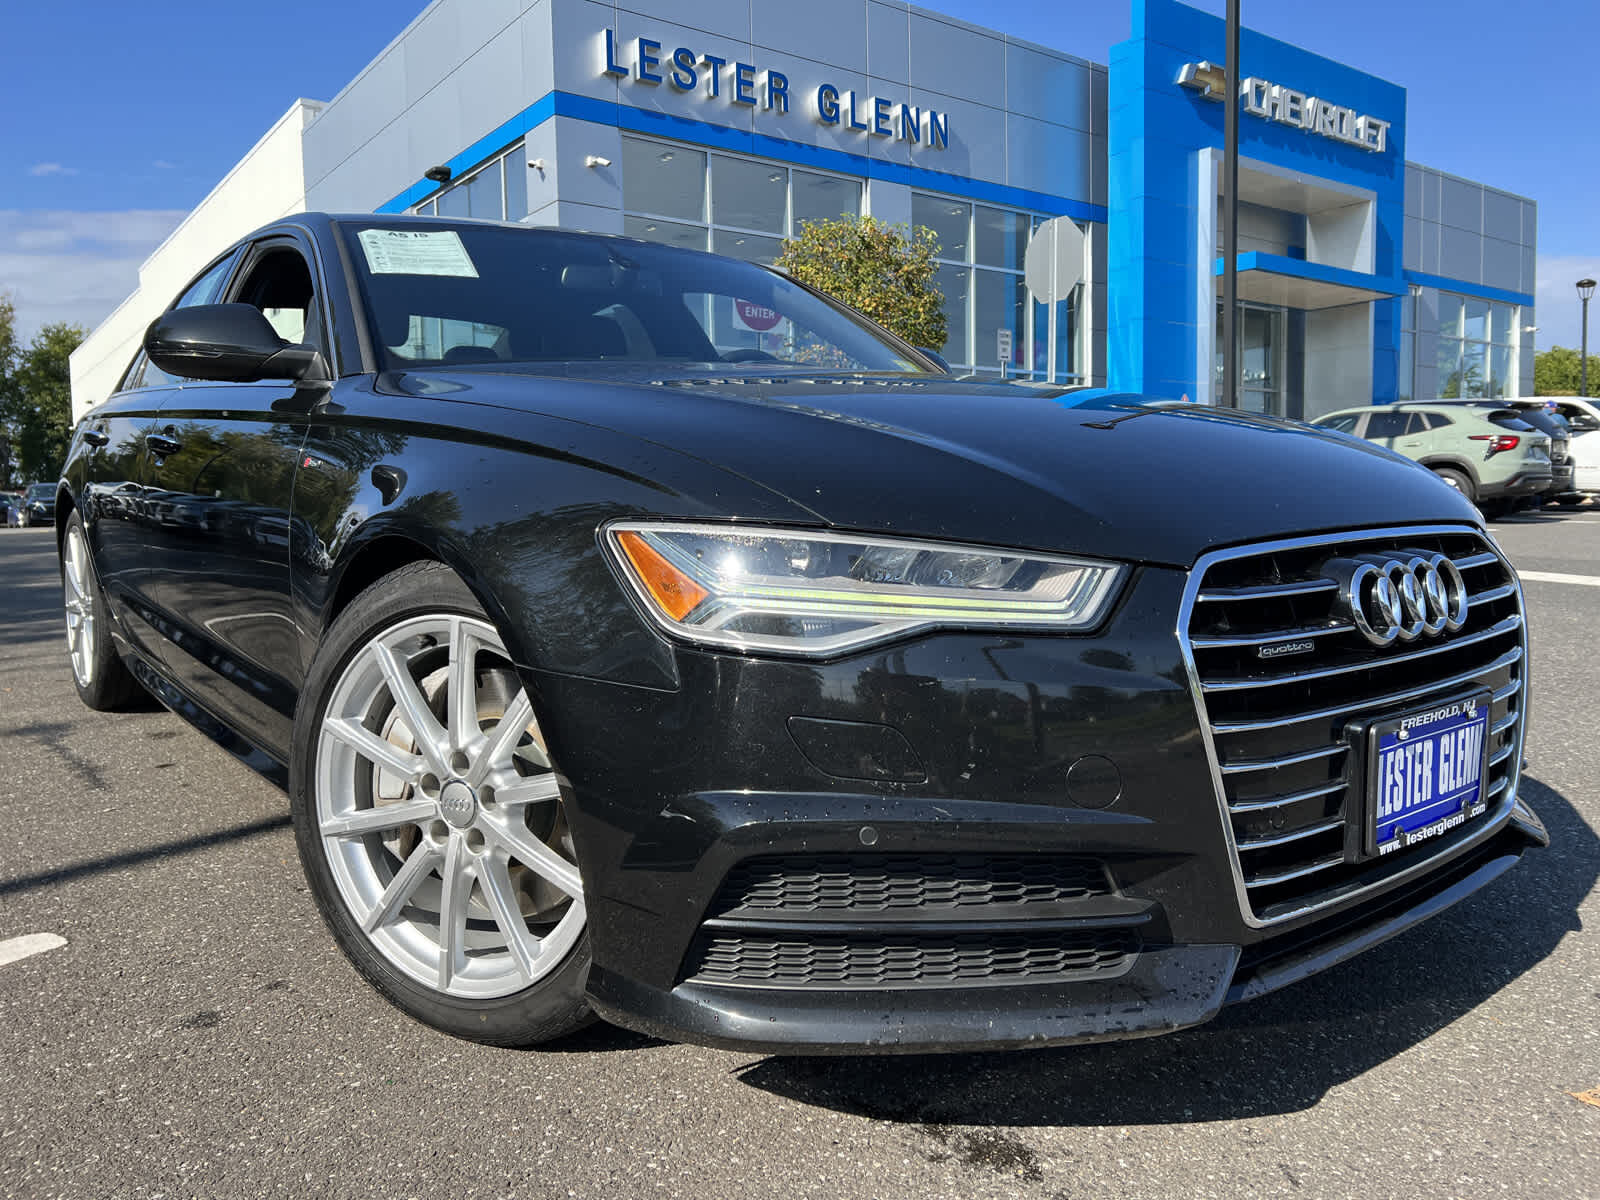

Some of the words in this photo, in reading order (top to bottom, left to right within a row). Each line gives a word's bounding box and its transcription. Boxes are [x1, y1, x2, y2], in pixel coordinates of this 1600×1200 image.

[601, 28, 789, 113] LESTER
[816, 83, 951, 149] GLENN
[1243, 76, 1391, 152] CHEVROLET
[744, 306, 776, 320] ENTER
[1263, 642, 1313, 655] quattro
[1401, 705, 1461, 731] FREEHOLD,
[1377, 739, 1434, 818] LESTER
[1439, 723, 1484, 795] GLENN
